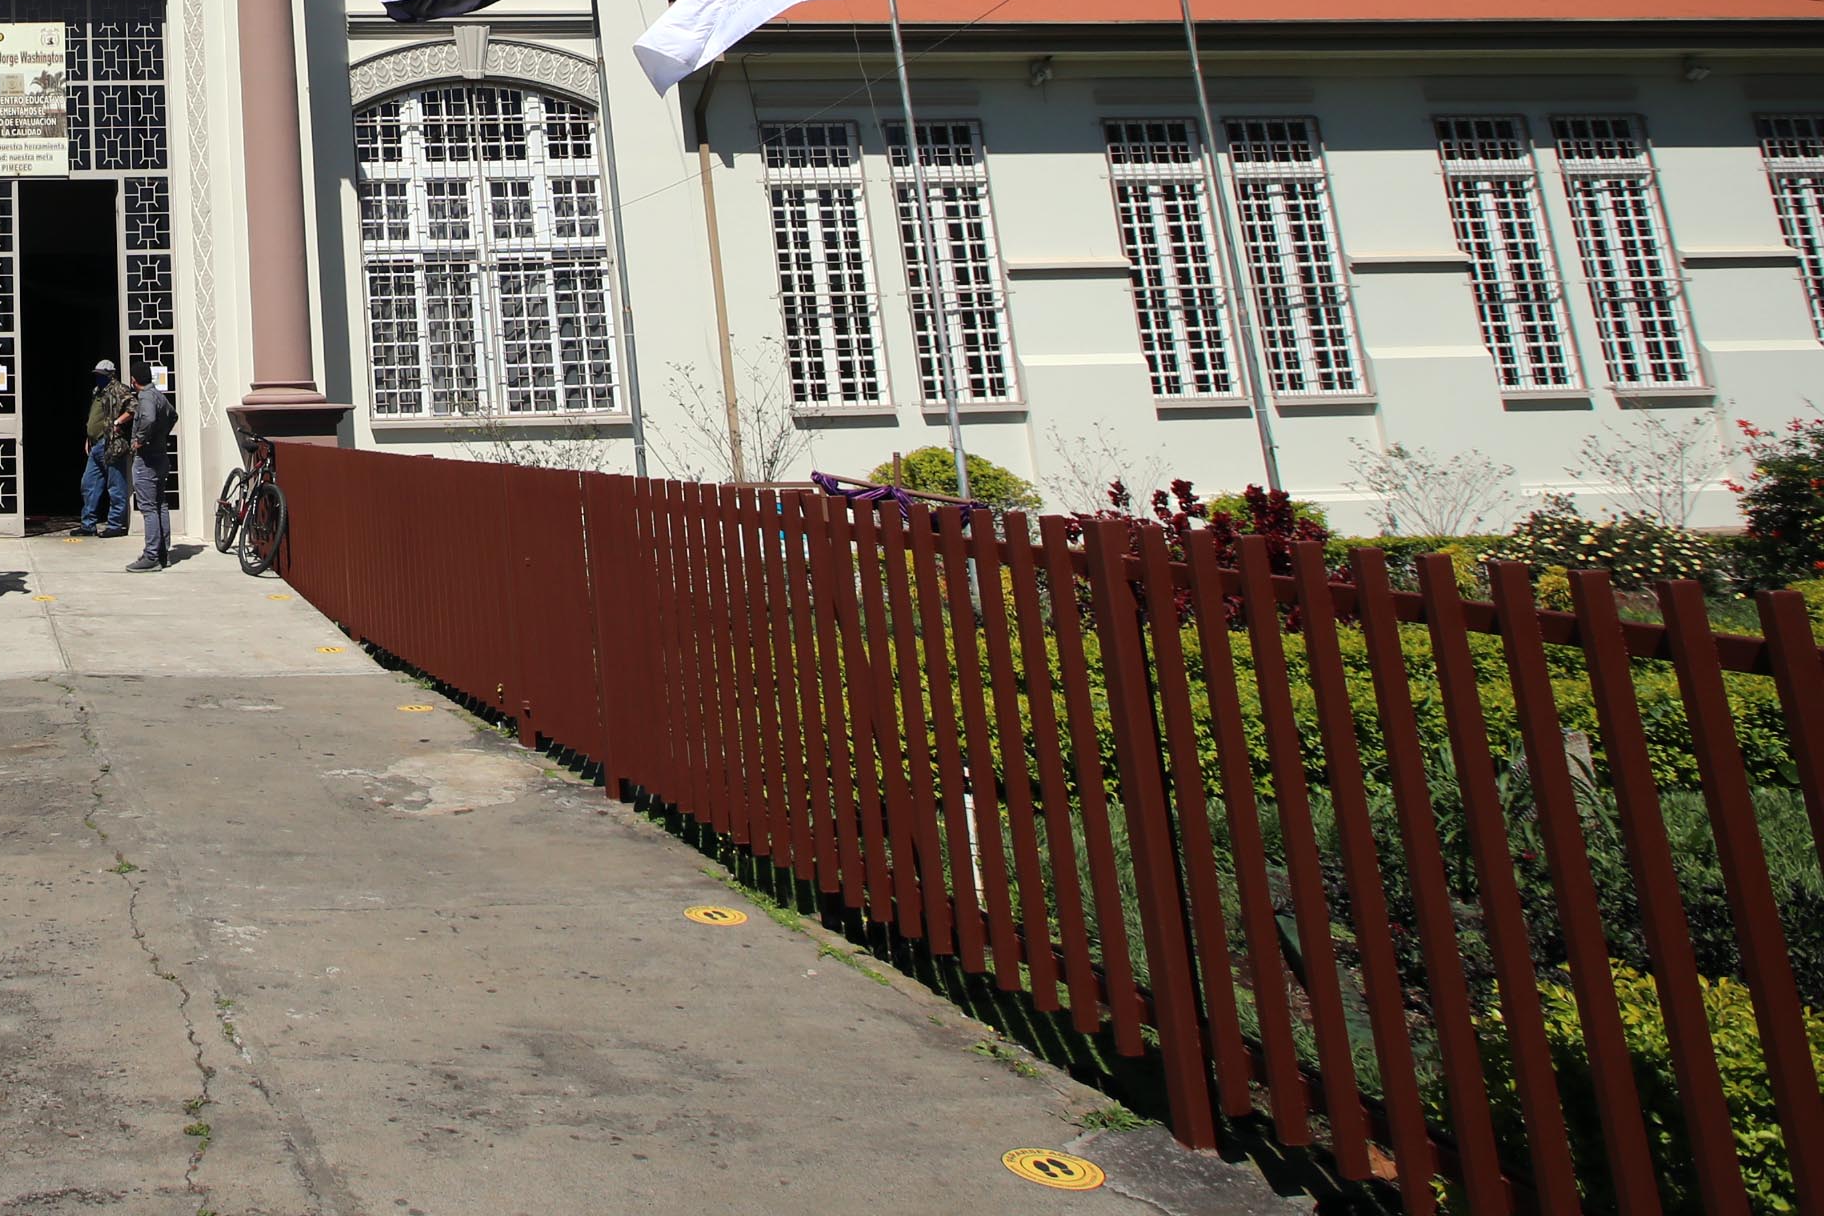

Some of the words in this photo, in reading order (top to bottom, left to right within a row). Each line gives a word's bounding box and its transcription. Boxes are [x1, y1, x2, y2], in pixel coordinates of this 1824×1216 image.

[20, 50, 64, 66] Washington
[25, 95, 66, 104] EDUCATIVO
[38, 106, 46, 115] EL
[5, 118, 14, 126] DE
[1, 128, 11, 136] LA
[11, 128, 42, 136] CALIDAD
